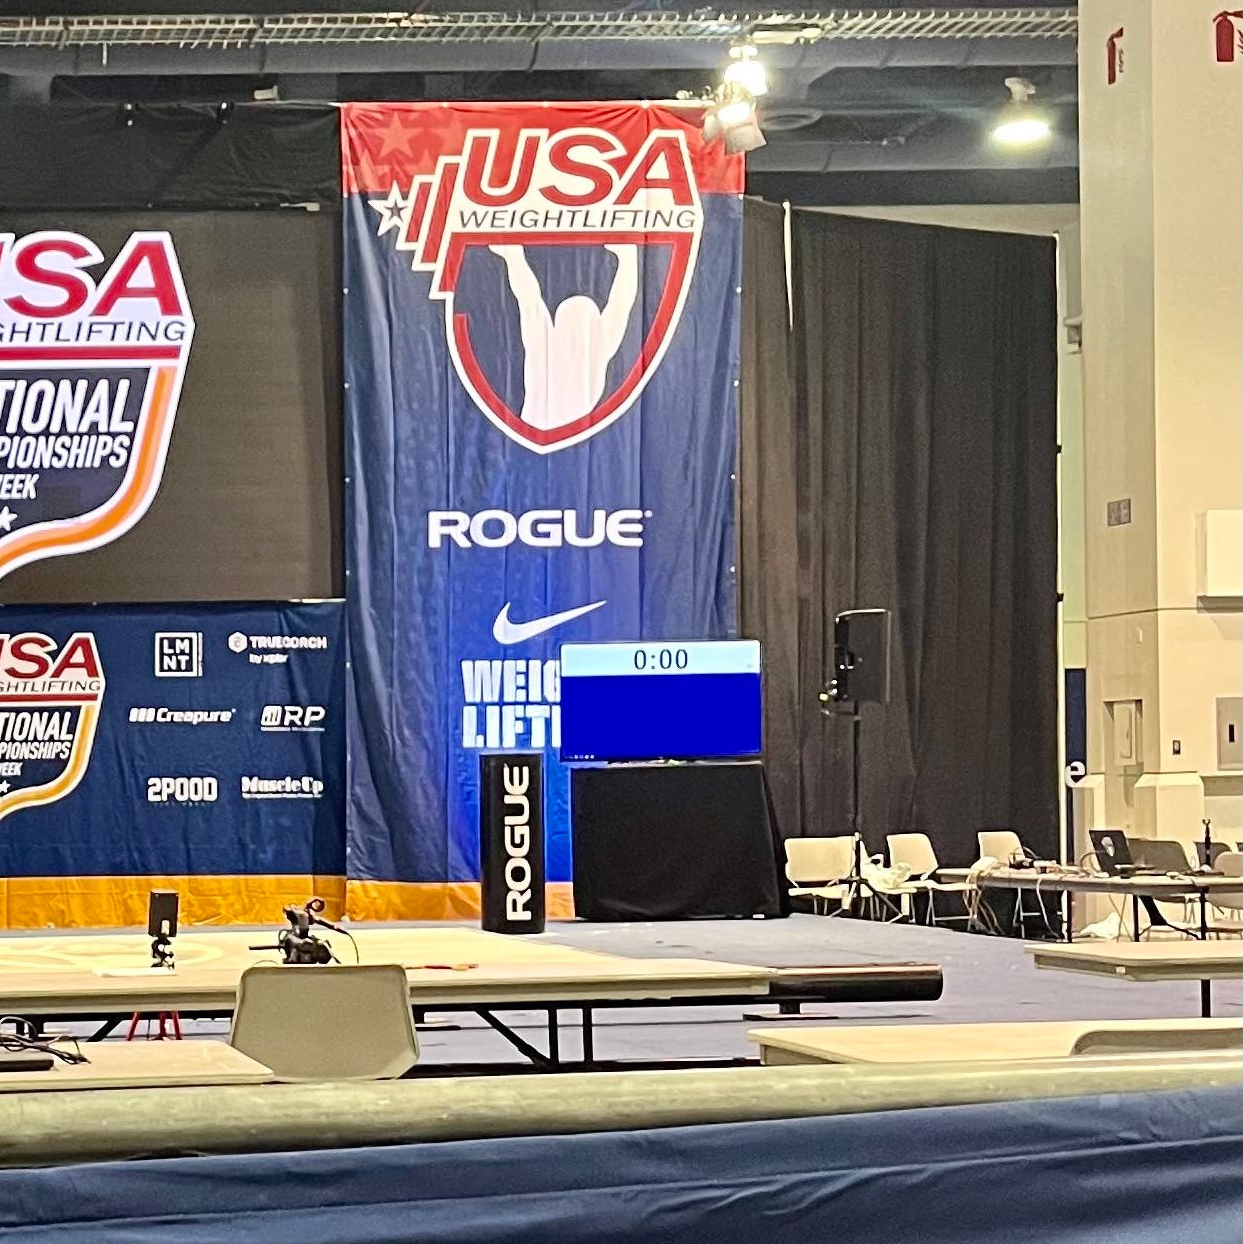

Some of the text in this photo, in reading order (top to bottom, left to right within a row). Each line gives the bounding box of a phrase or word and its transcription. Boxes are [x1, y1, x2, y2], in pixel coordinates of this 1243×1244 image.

[460, 132, 695, 208] USA
[458, 208, 696, 229] WEIGHTLIFTING
[427, 510, 644, 549] ROGUE
[633, 648, 689, 671] 0:00
[461, 659, 562, 703] WEIG
[156, 707, 232, 725] Creapure
[283, 705, 326, 727] RP
[462, 704, 562, 749] LIFTI
[147, 777, 218, 802] 2POOD
[503, 763, 532, 922] ROGUE
